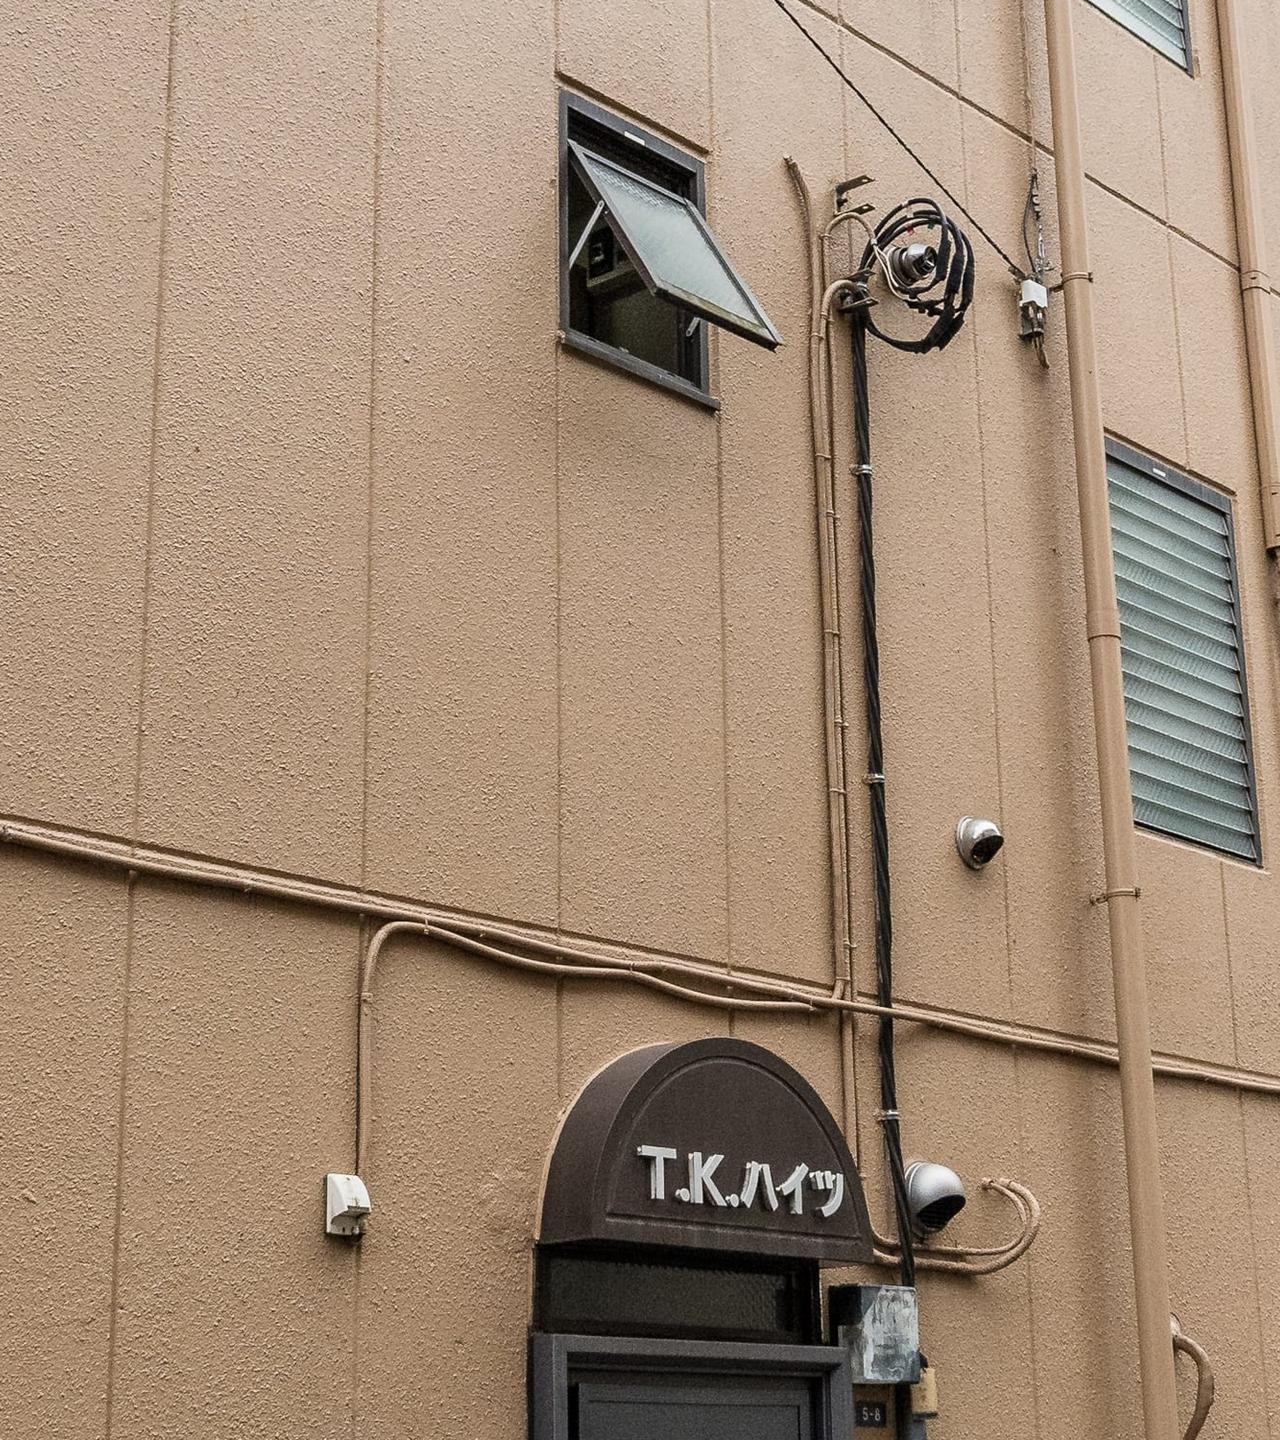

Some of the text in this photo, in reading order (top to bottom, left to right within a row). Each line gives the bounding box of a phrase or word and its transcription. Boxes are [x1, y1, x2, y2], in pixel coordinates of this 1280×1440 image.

[636, 1144, 844, 1217] T.K.ハイツ
[862, 1407, 881, 1421] 5-8
